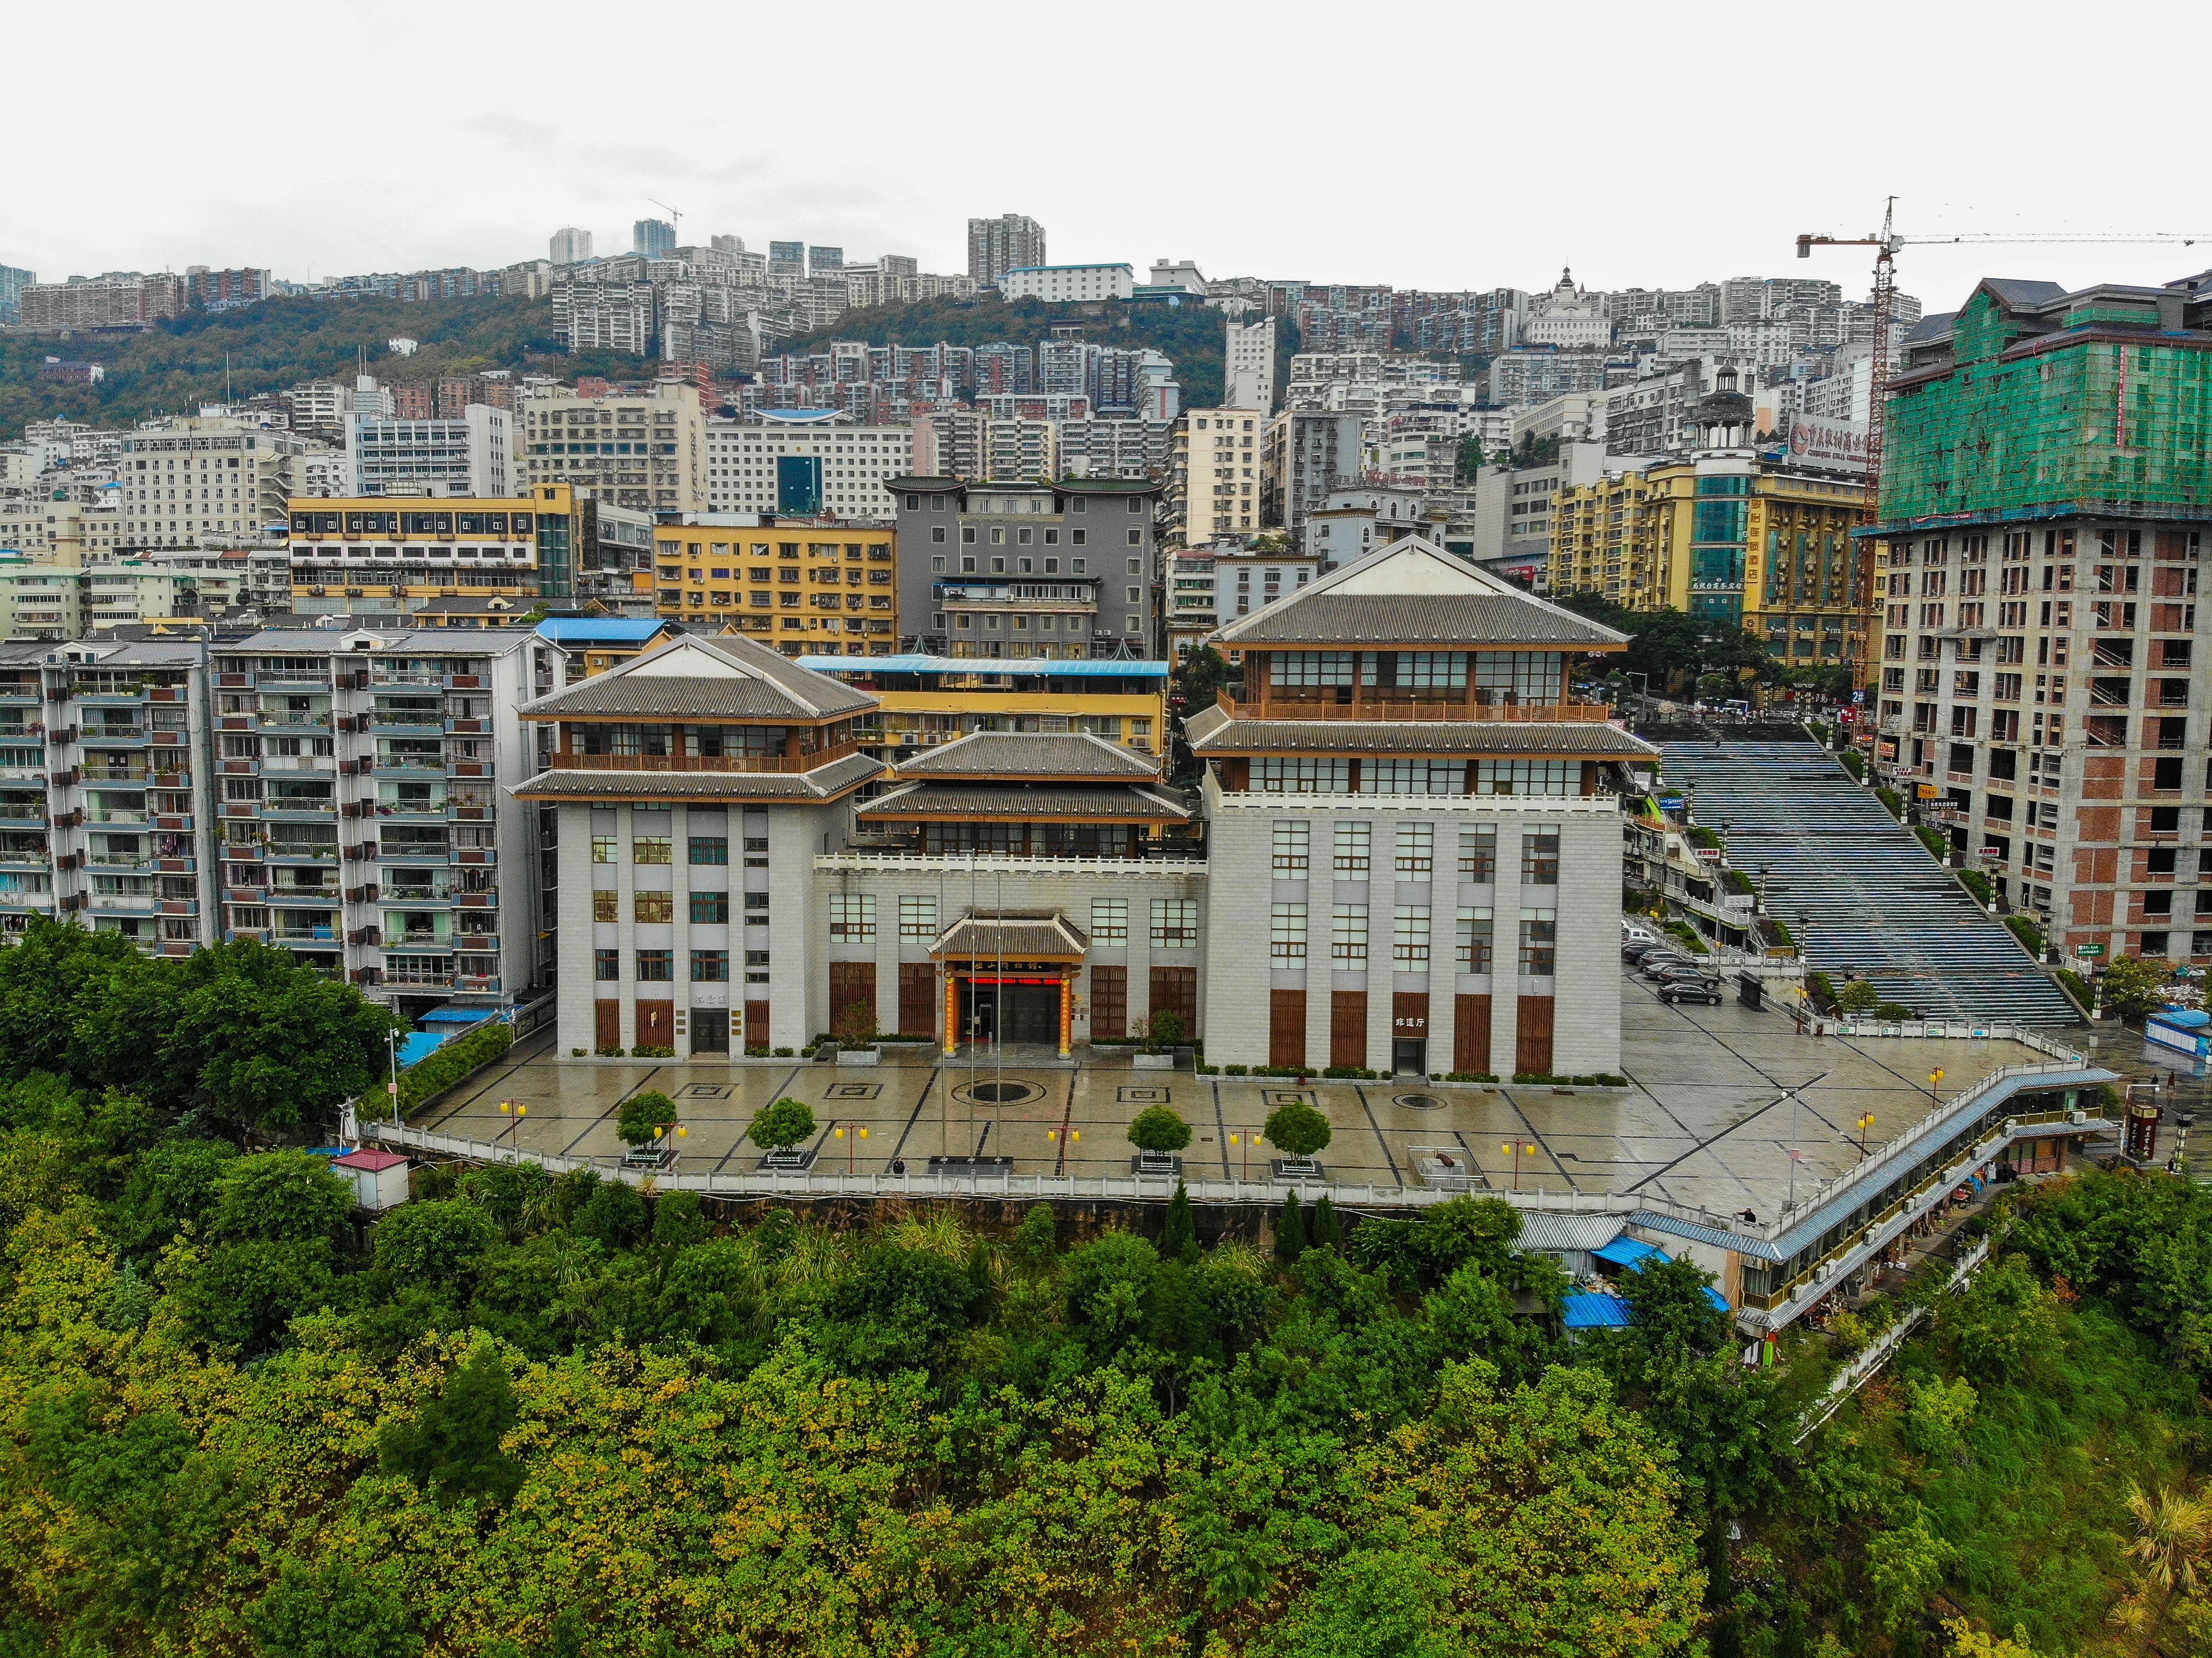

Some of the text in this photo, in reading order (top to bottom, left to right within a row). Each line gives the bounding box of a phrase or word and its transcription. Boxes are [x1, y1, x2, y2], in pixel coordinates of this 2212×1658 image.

[1852, 691, 1864, 702] 2#
[1396, 1017, 1425, 1027] 非遗厅
